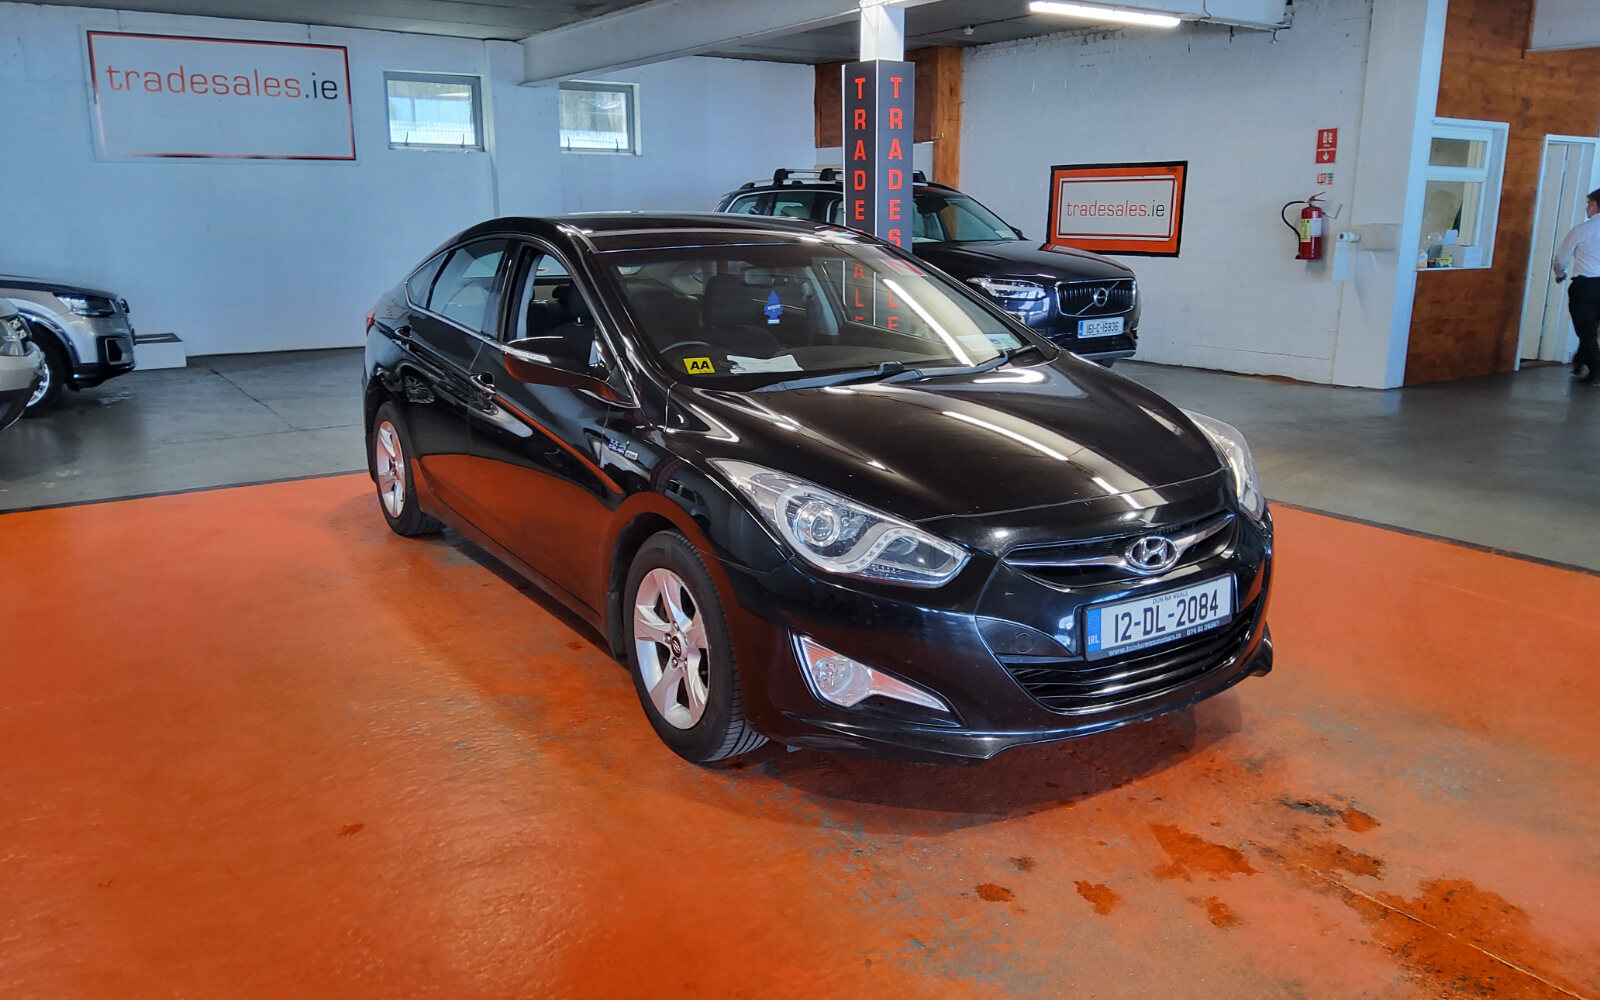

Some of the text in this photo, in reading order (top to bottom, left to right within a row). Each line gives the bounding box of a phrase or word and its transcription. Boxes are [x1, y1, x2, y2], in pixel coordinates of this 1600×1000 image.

[105, 64, 338, 100] tradesales.ie
[1066, 199, 1165, 217] tradesales.ie
[690, 360, 710, 370] AA
[1114, 589, 1219, 643] 12-DL-2084
[1087, 634, 1100, 646] IRL
